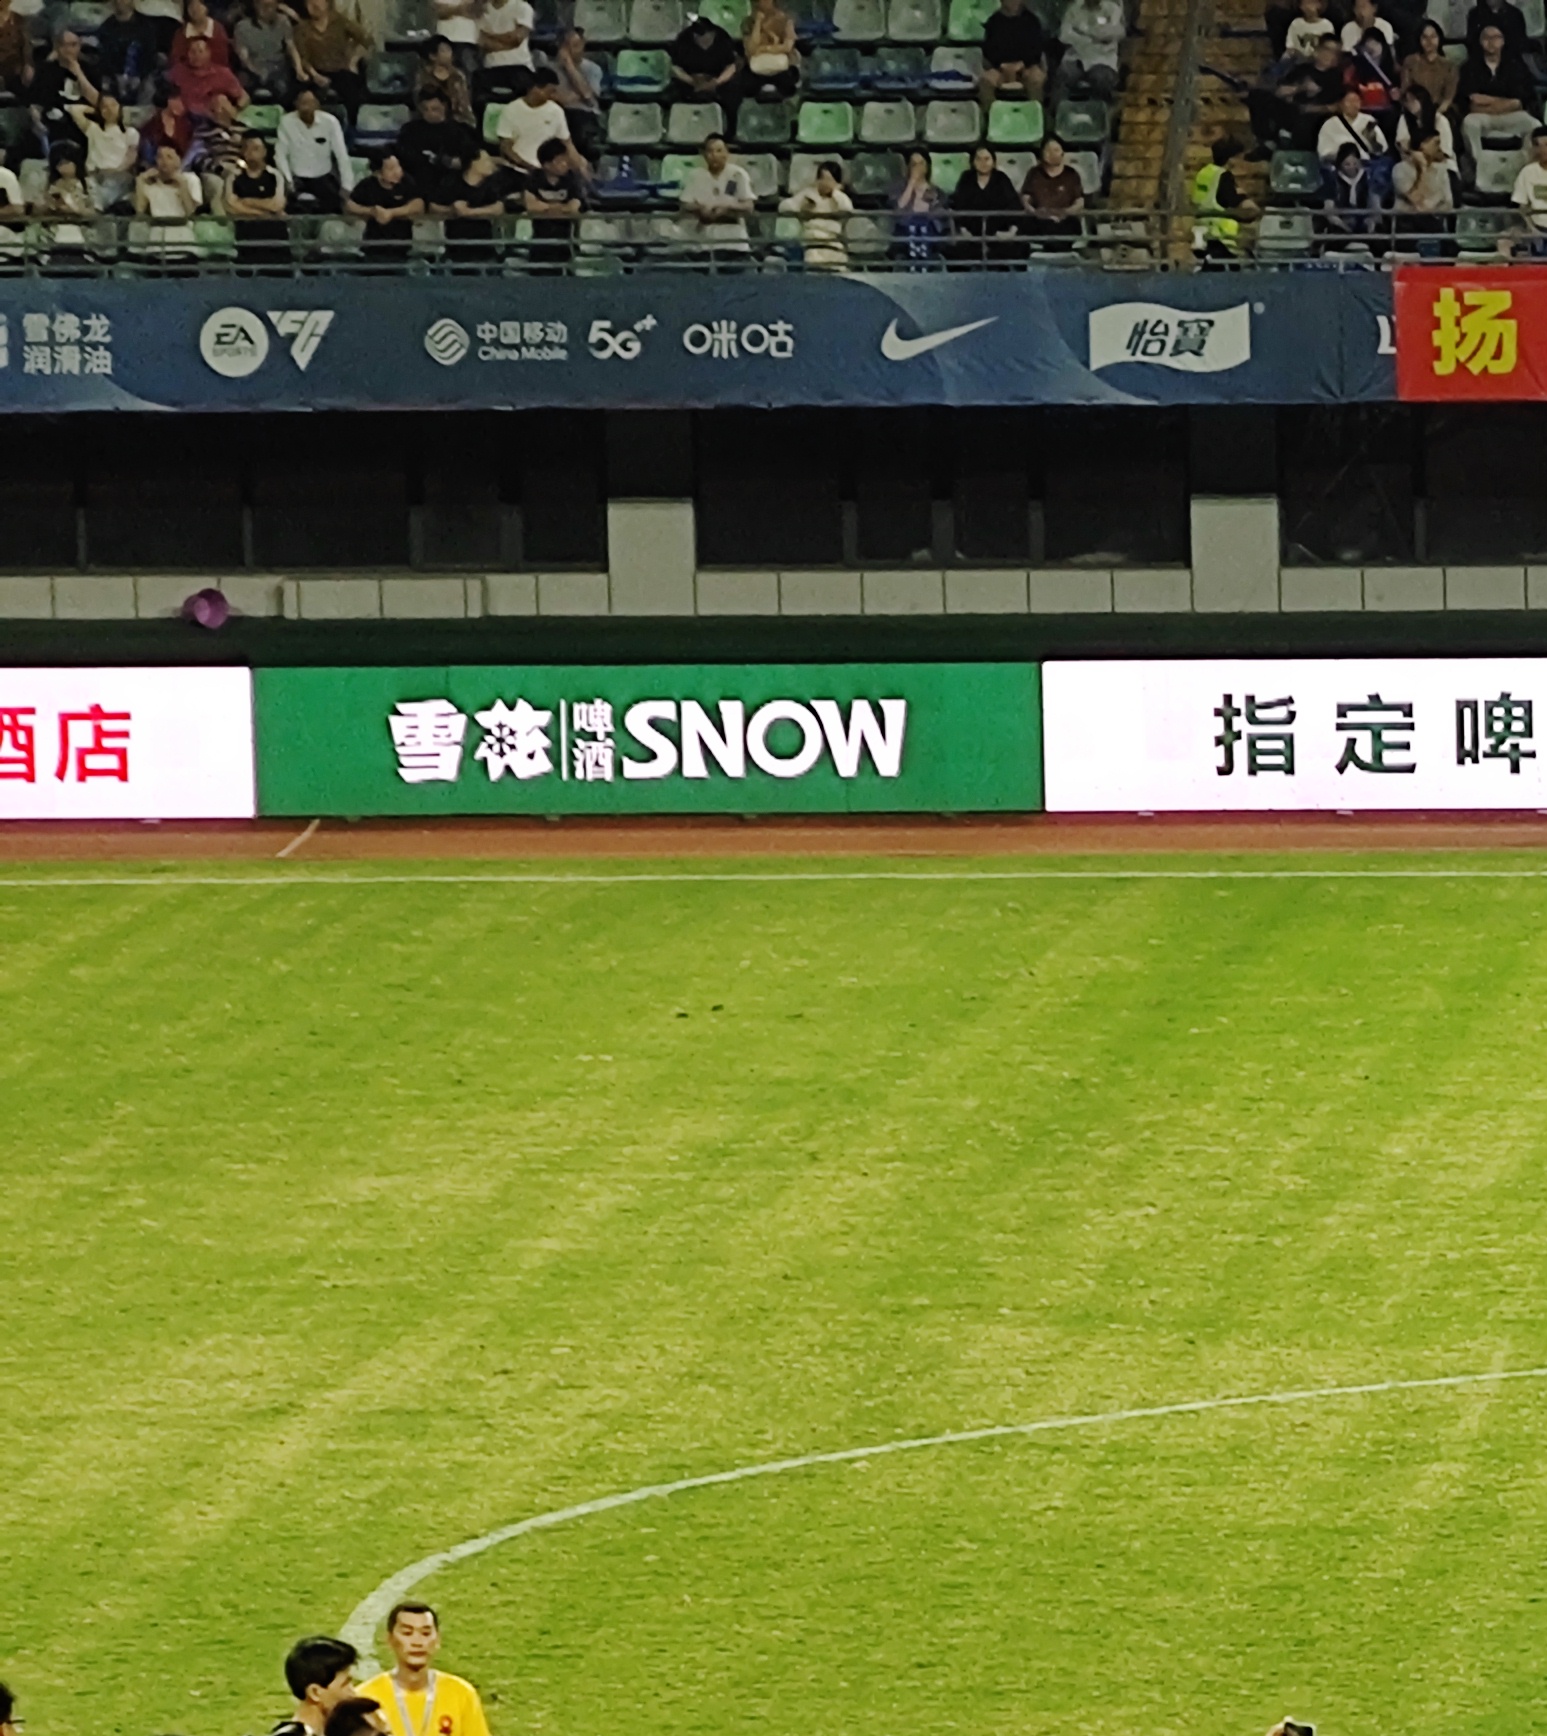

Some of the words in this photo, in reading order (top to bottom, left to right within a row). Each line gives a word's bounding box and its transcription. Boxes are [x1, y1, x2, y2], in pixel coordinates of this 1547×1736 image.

[214, 323, 255, 346] EA
[476, 321, 568, 344] 中国移动
[23, 345, 112, 375] 润滑油
[477, 346, 519, 361] China
[521, 346, 569, 361] Mobile
[388, 698, 554, 783] 雪花
[622, 699, 907, 778] SNOW
